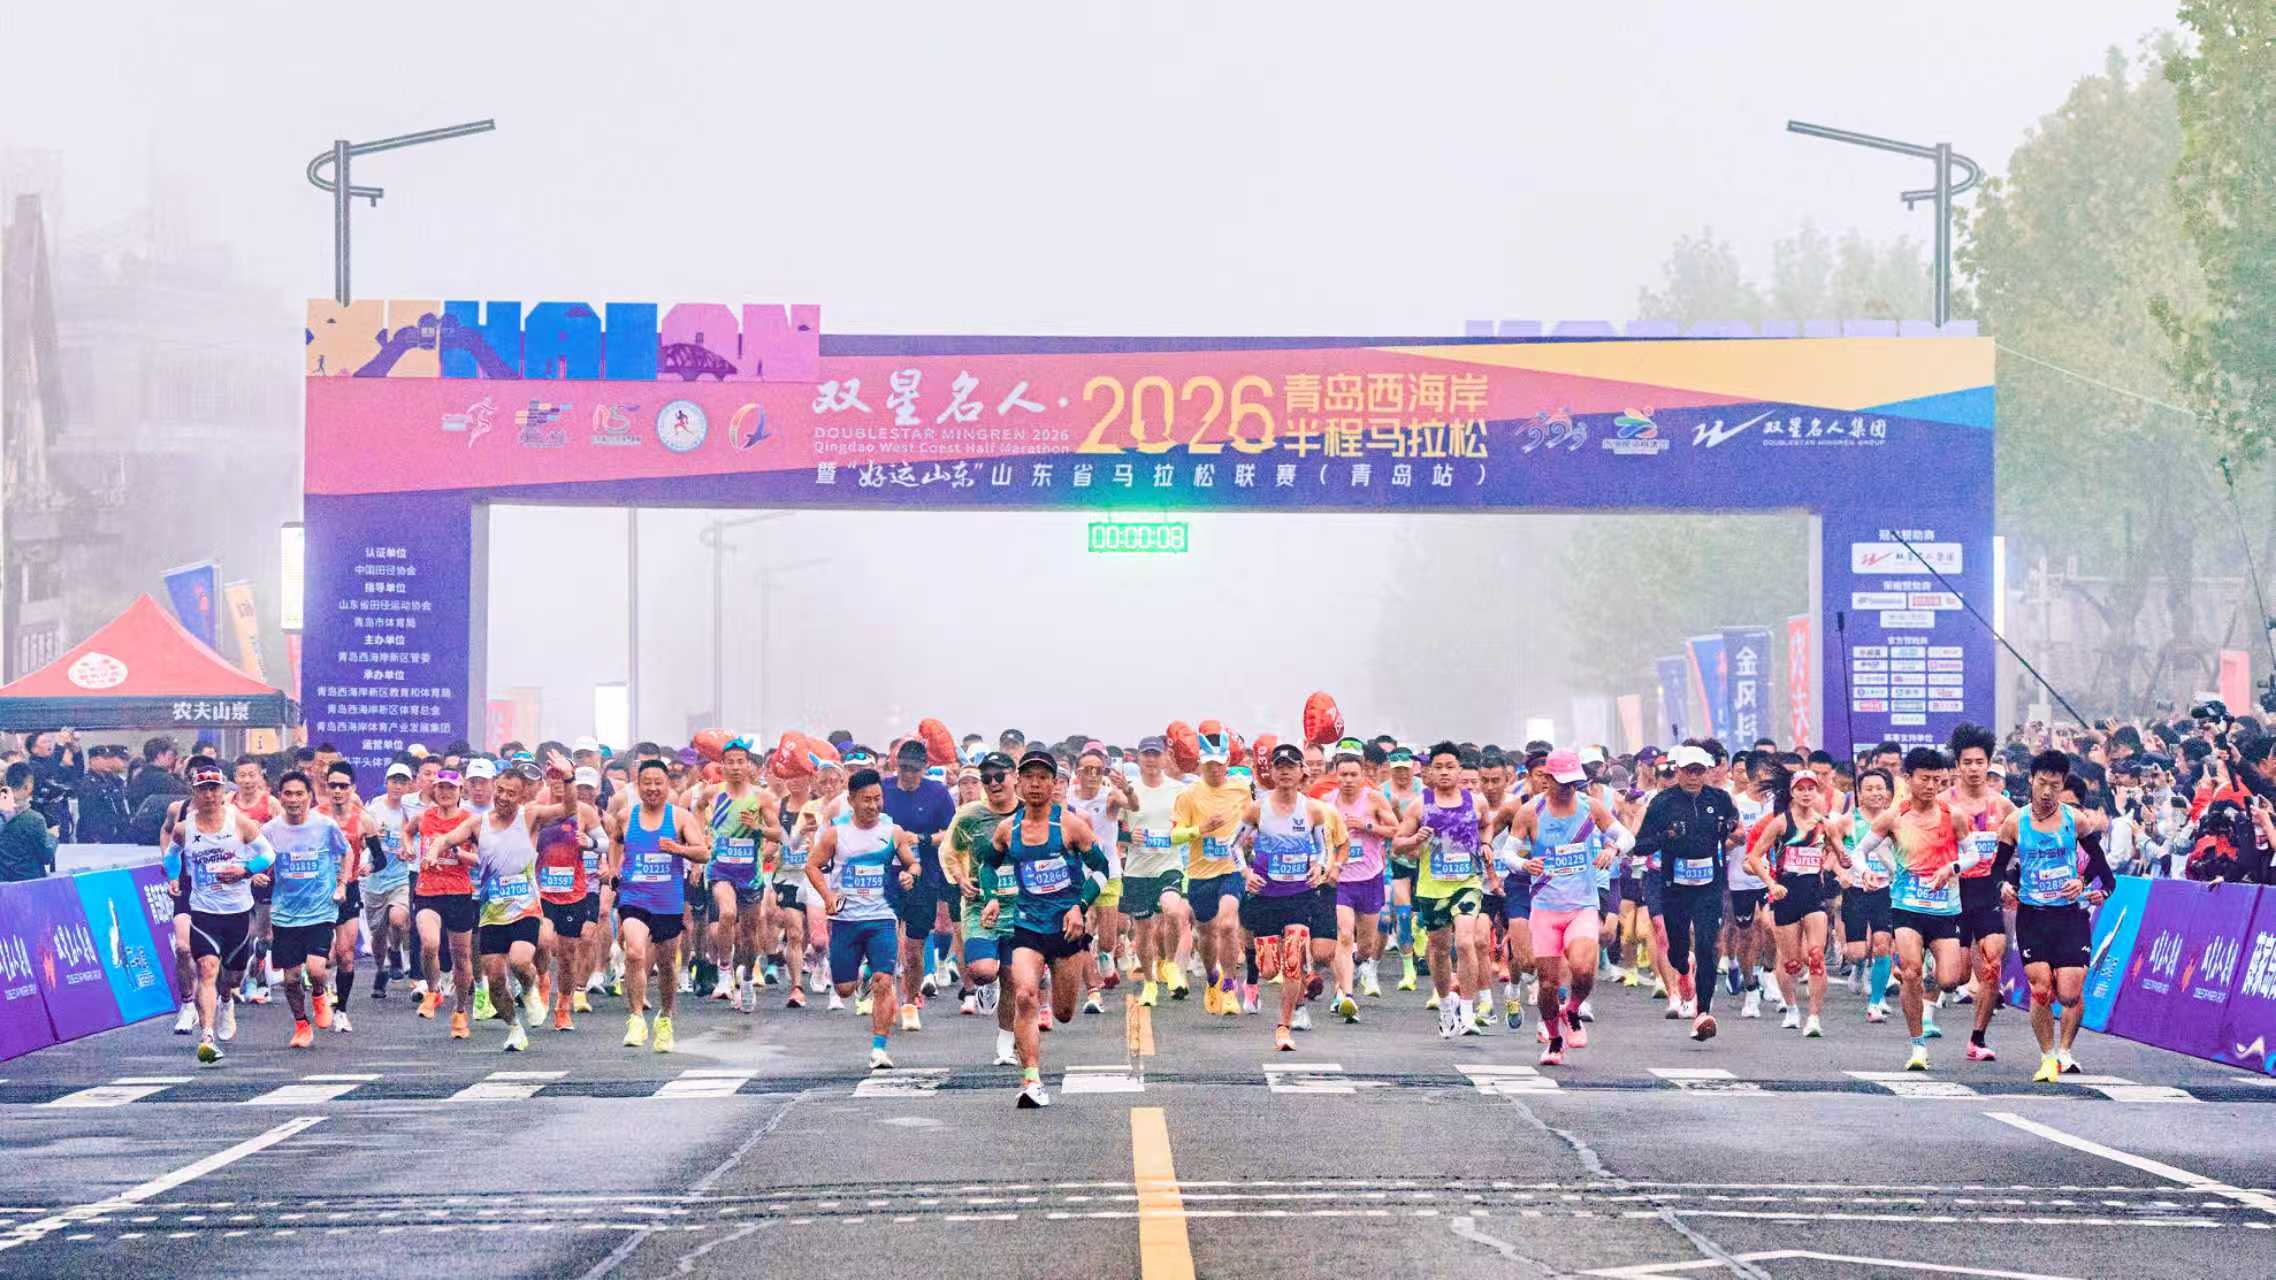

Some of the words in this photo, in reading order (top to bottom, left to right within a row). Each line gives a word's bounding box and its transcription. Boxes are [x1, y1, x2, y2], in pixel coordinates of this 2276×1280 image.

[1284, 373, 1489, 413] 青岛西海岸
[1077, 375, 1276, 454] 2026
[1763, 417, 1886, 438] 双星名人集团
[815, 427, 935, 440] DOUBLESTAR
[942, 427, 1025, 440] MINGREN
[1032, 428, 1069, 441] 2026
[1283, 418, 1489, 458] 半程马拉松
[815, 441, 875, 454] Qingdao
[880, 442, 914, 453] West
[920, 442, 961, 453] Coast
[965, 442, 996, 453] Half
[1001, 442, 1069, 453] Marathon
[1091, 525, 1185, 549] 00:00:08
[365, 547, 407, 558] 认证单位
[354, 564, 416, 576] 中国田径协会
[365, 582, 406, 593] 指导单位
[339, 600, 432, 610] 山东省田径运动协会
[354, 617, 416, 628] 青岛市体育局
[364, 634, 405, 645] 主办单位
[363, 670, 404, 680] 承办单位
[317, 686, 451, 698] 青岛西海岸新区教育和体育局
[173, 701, 250, 721] 农夫山泉
[854, 876, 883, 887] 01759
[2039, 879, 2065, 891] 0288
